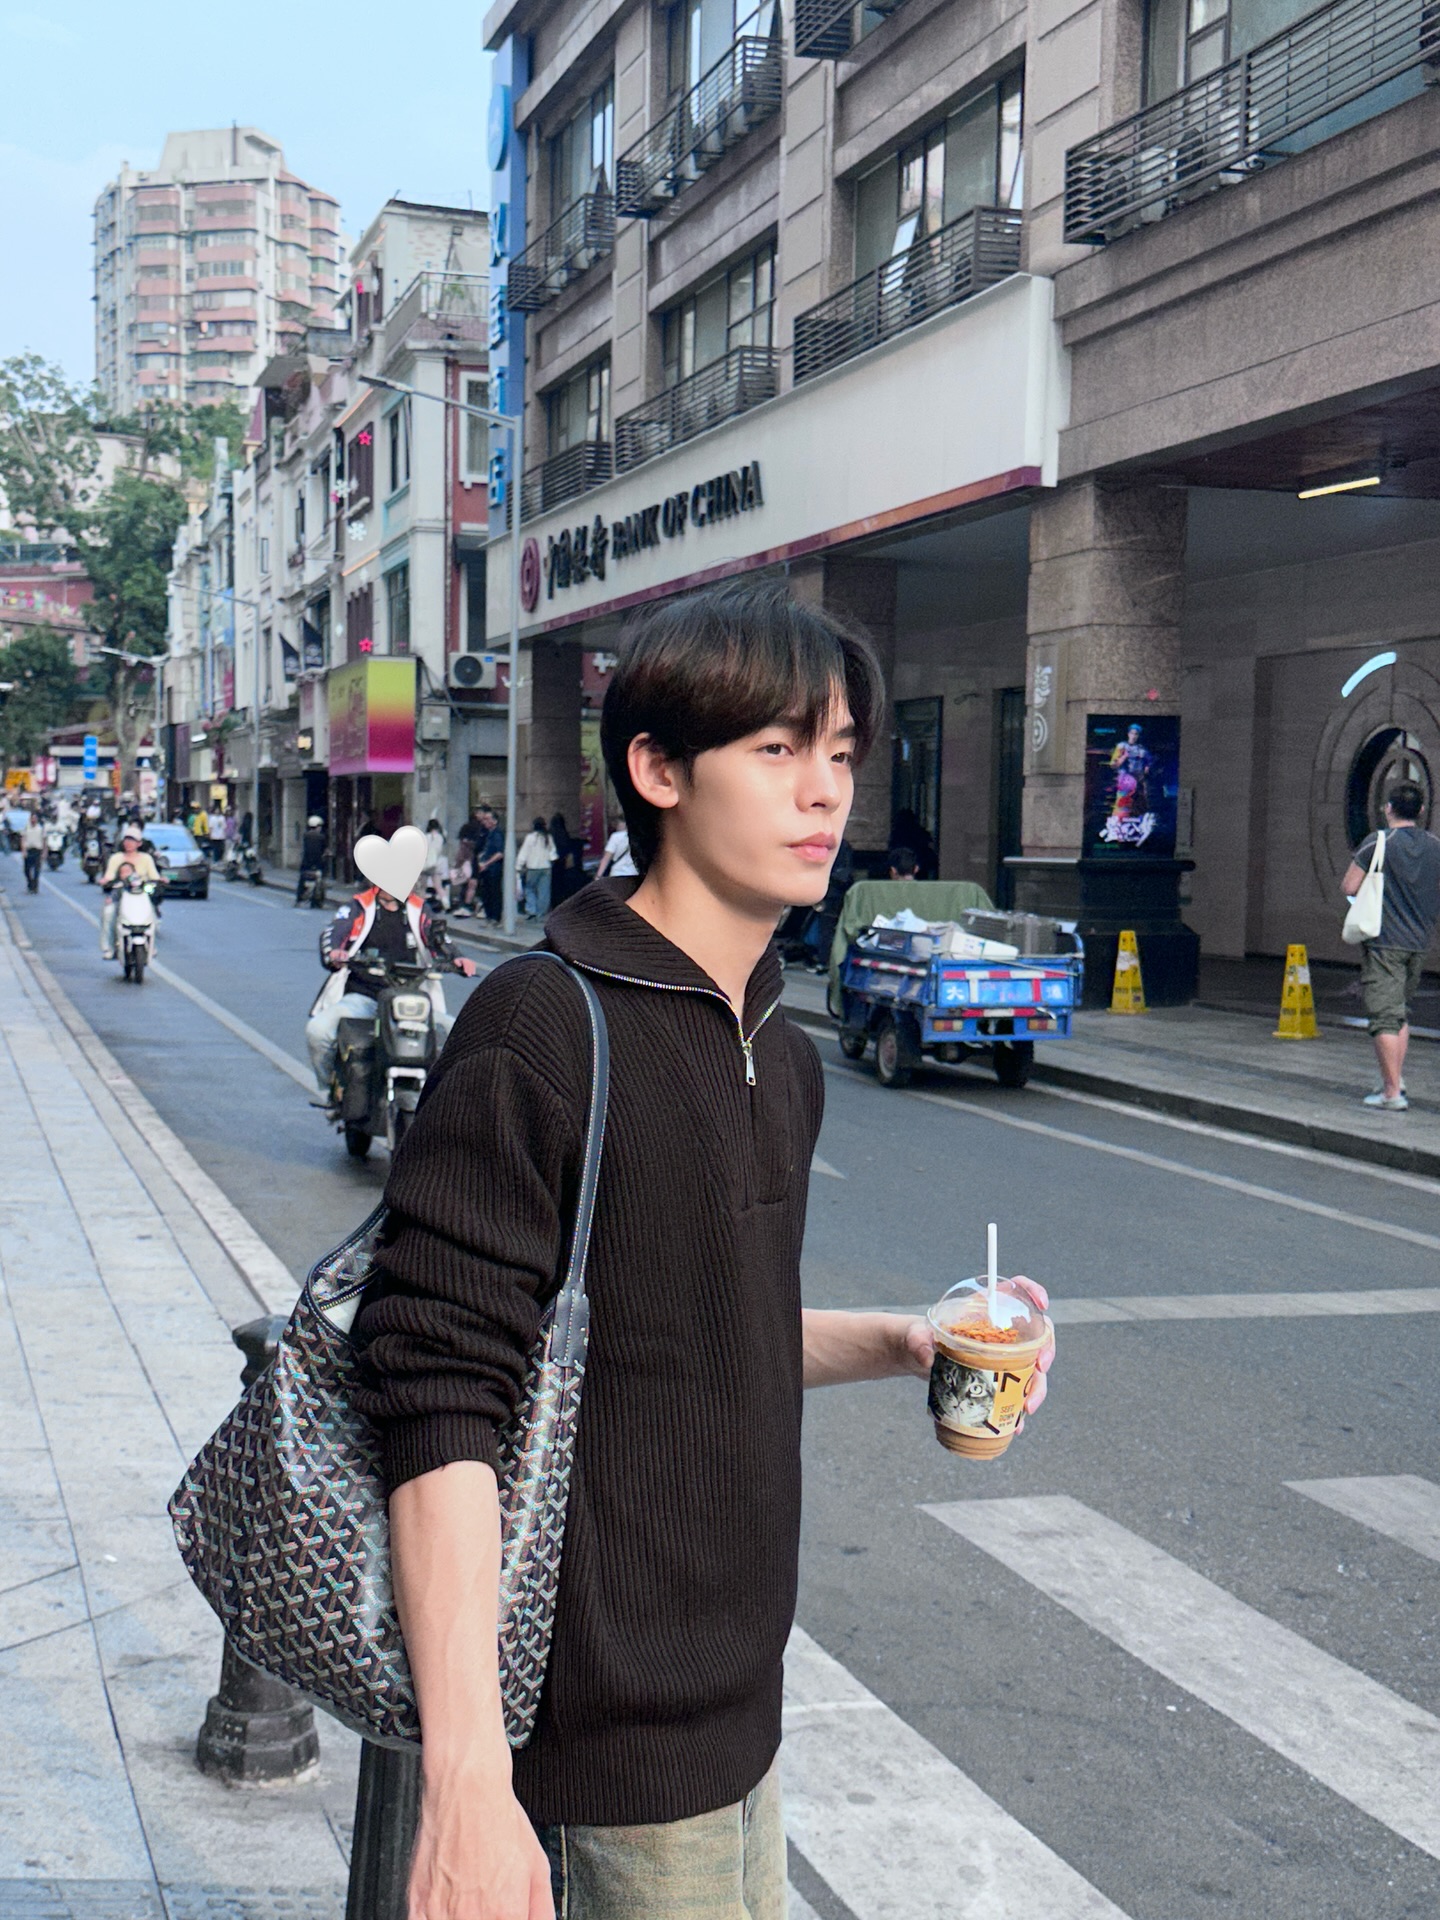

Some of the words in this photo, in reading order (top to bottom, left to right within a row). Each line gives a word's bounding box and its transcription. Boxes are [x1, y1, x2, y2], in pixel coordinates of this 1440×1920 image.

[611, 504, 661, 560] BANK
[662, 491, 689, 538] OF
[690, 460, 764, 528] CHINA
